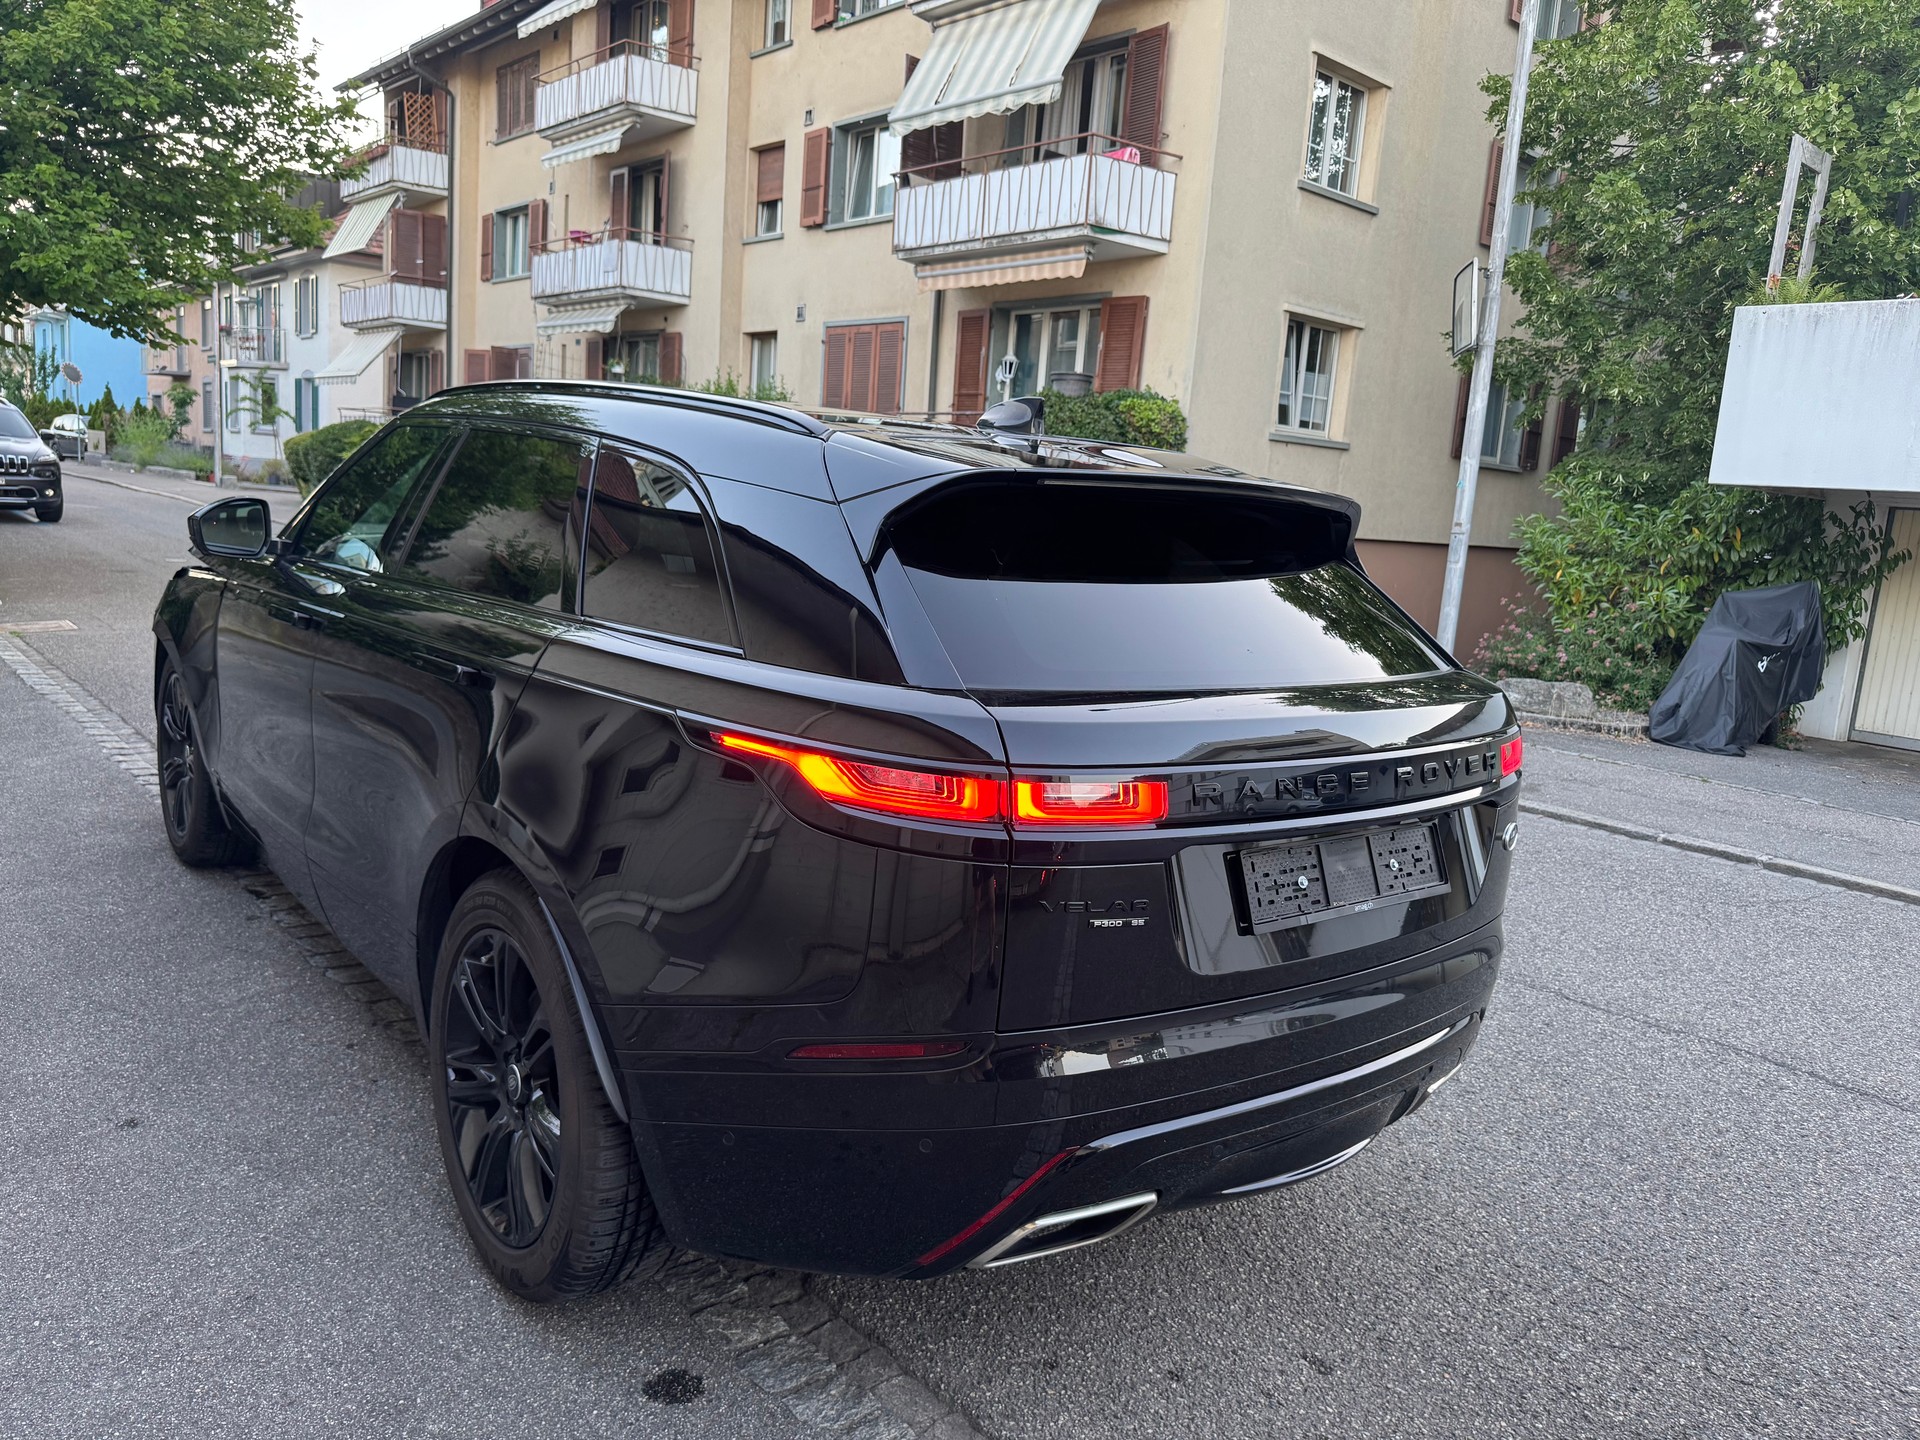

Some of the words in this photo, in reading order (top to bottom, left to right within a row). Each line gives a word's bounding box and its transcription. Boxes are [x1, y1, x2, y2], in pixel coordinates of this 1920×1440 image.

[1192, 771, 1369, 806] RANGE
[1394, 751, 1497, 790] ROVER
[1039, 899, 1150, 913] VELAR
[1093, 920, 1123, 928] P300
